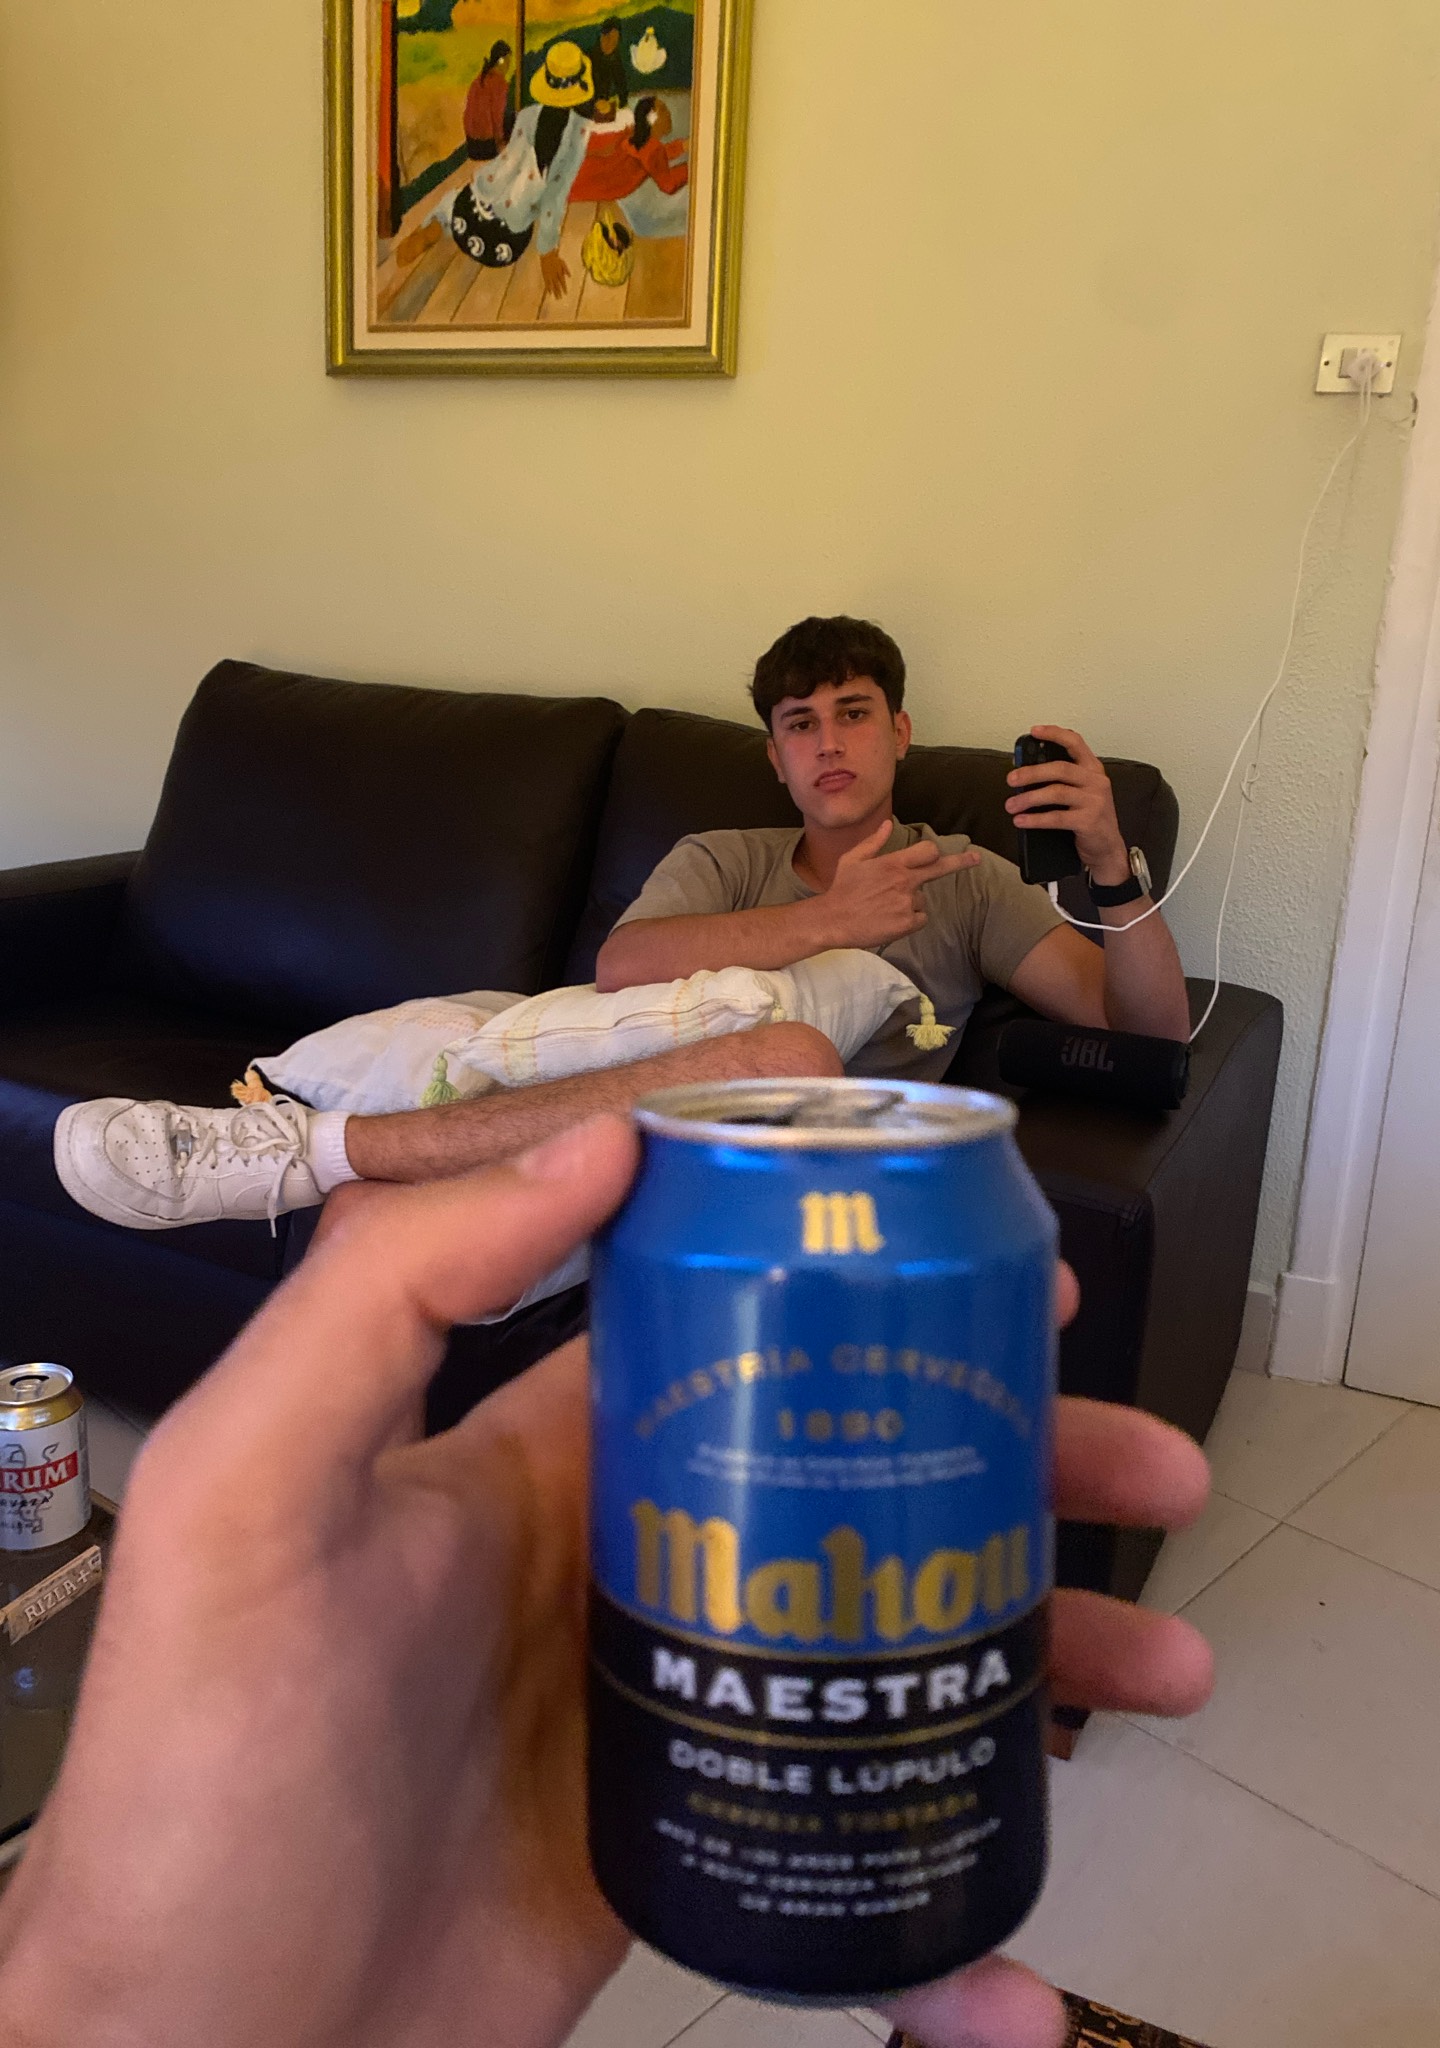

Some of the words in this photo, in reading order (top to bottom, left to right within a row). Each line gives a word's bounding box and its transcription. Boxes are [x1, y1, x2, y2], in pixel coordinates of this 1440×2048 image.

[1060, 1036, 1114, 1072] JBL
[652, 1648, 1010, 1723] MAESTRA
[668, 1738, 812, 1795] DOBLE
